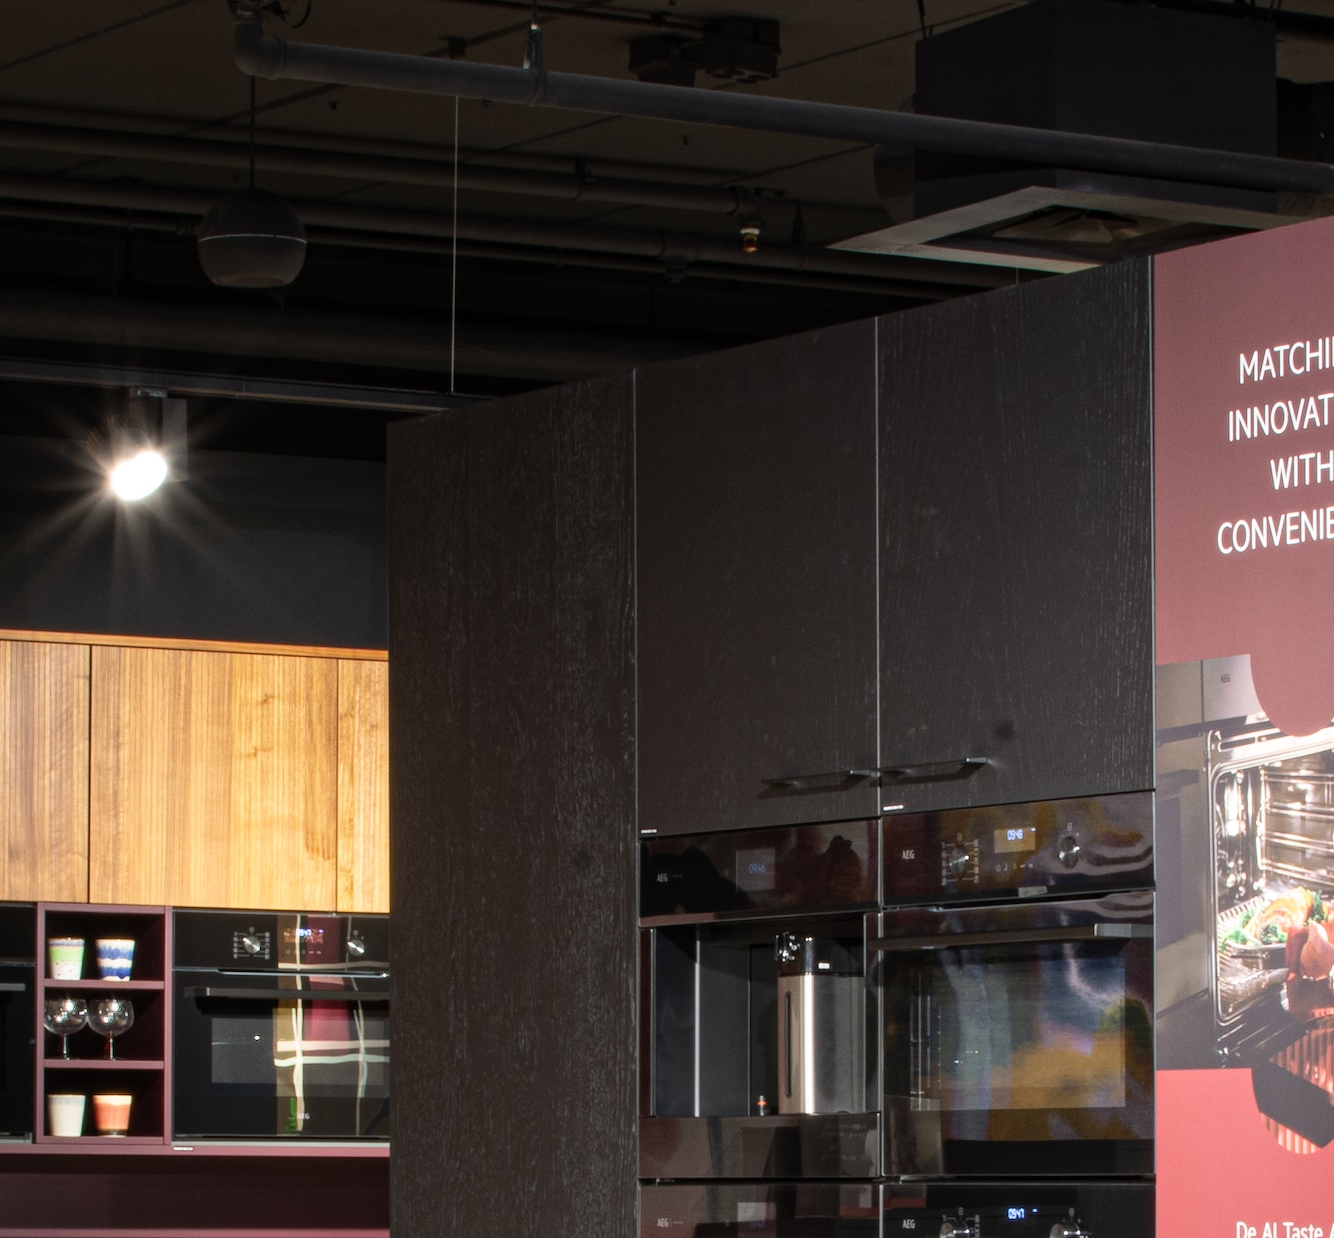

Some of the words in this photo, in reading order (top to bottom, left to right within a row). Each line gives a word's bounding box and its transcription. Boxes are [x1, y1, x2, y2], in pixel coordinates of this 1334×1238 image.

[1270, 449, 1334, 490] WITH
[901, 849, 916, 861] AEG
[656, 1217, 669, 1229] AEG
[901, 1218, 916, 1230] AEG
